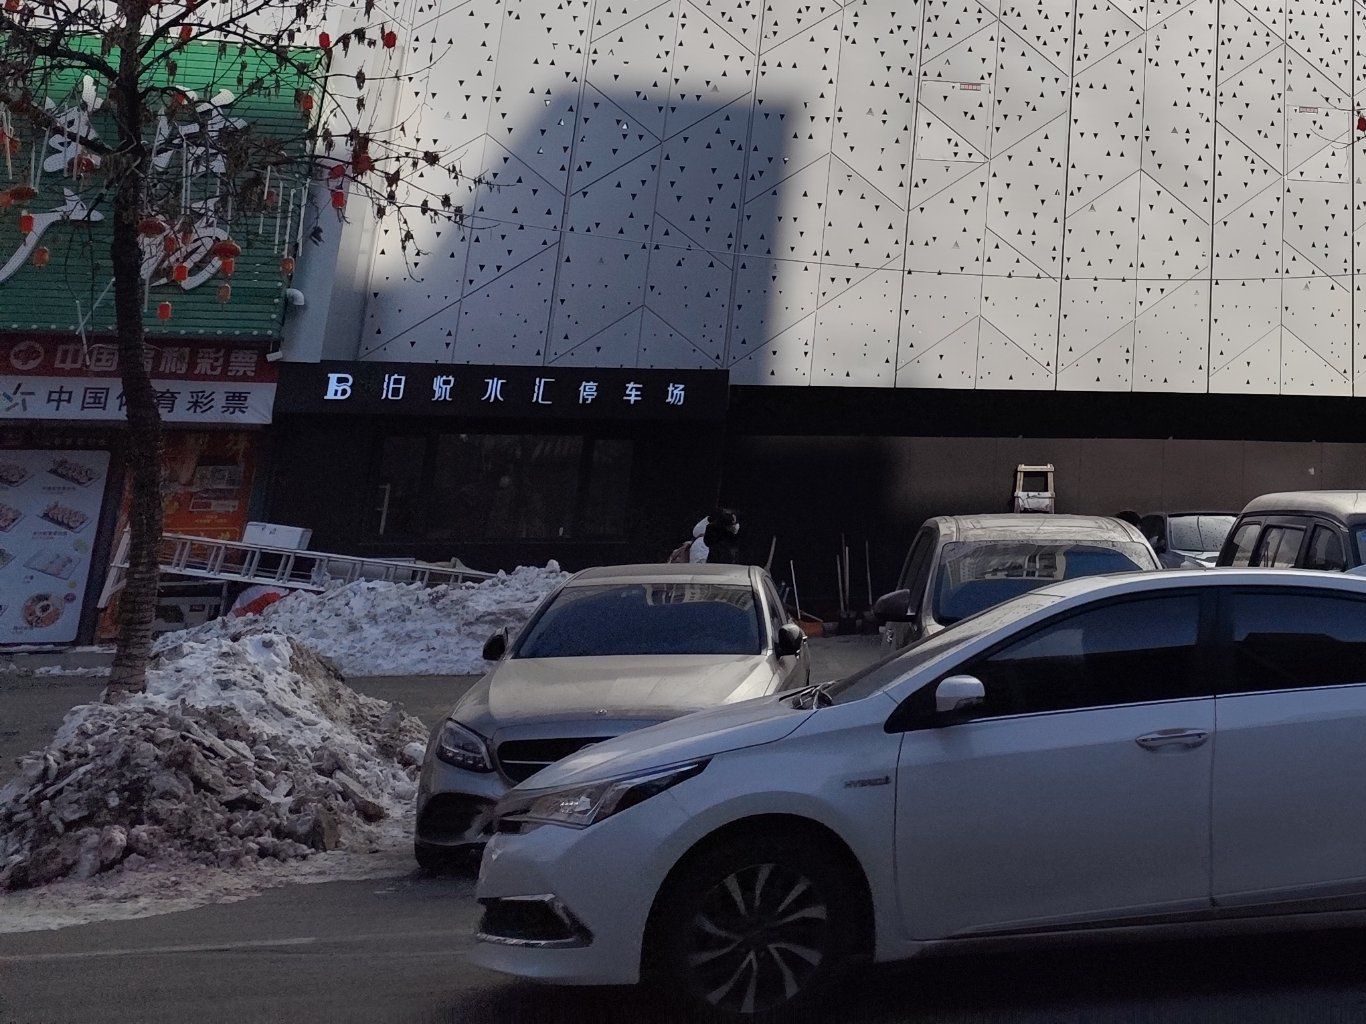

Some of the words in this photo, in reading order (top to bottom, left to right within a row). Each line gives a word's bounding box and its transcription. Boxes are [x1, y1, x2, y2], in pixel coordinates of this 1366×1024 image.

[380, 372, 687, 407] 泊悦水汇停车场
